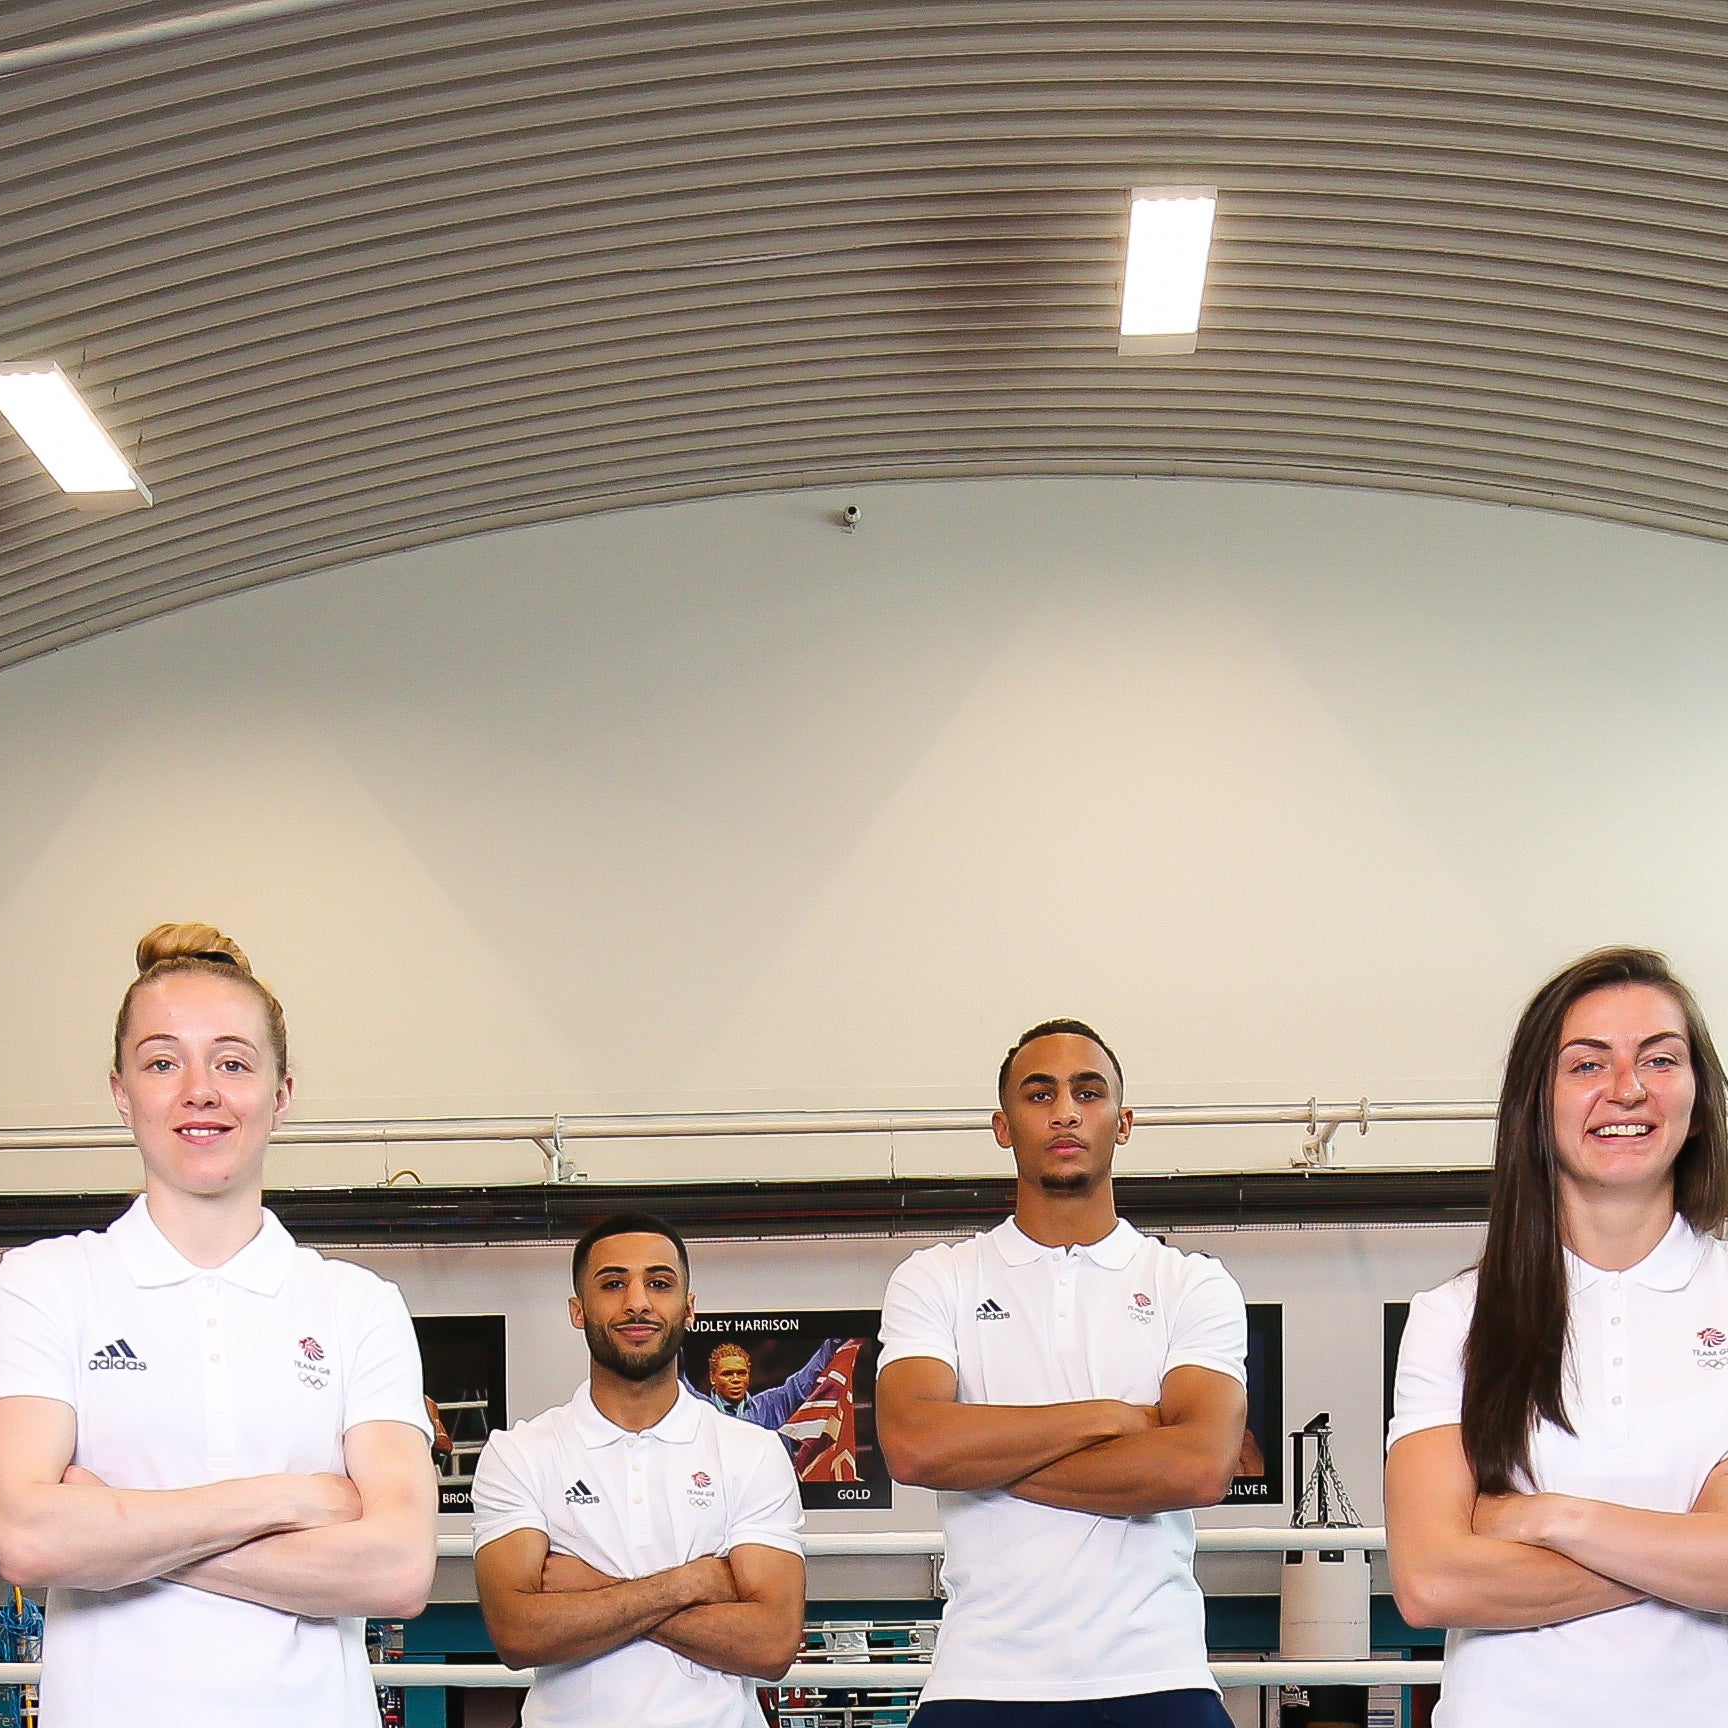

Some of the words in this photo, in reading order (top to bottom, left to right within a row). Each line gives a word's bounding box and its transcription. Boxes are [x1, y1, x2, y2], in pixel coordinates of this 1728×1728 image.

[735, 1318, 799, 1332] HARRISON
[1692, 1349, 1718, 1357] TEAM
[88, 1357, 148, 1372] adidas
[293, 1359, 317, 1373] TEAM
[317, 1367, 331, 1376] GB
[686, 1488, 704, 1497] TEAM
[837, 1489, 870, 1500] GOLD
[1226, 1484, 1268, 1495] SILVER
